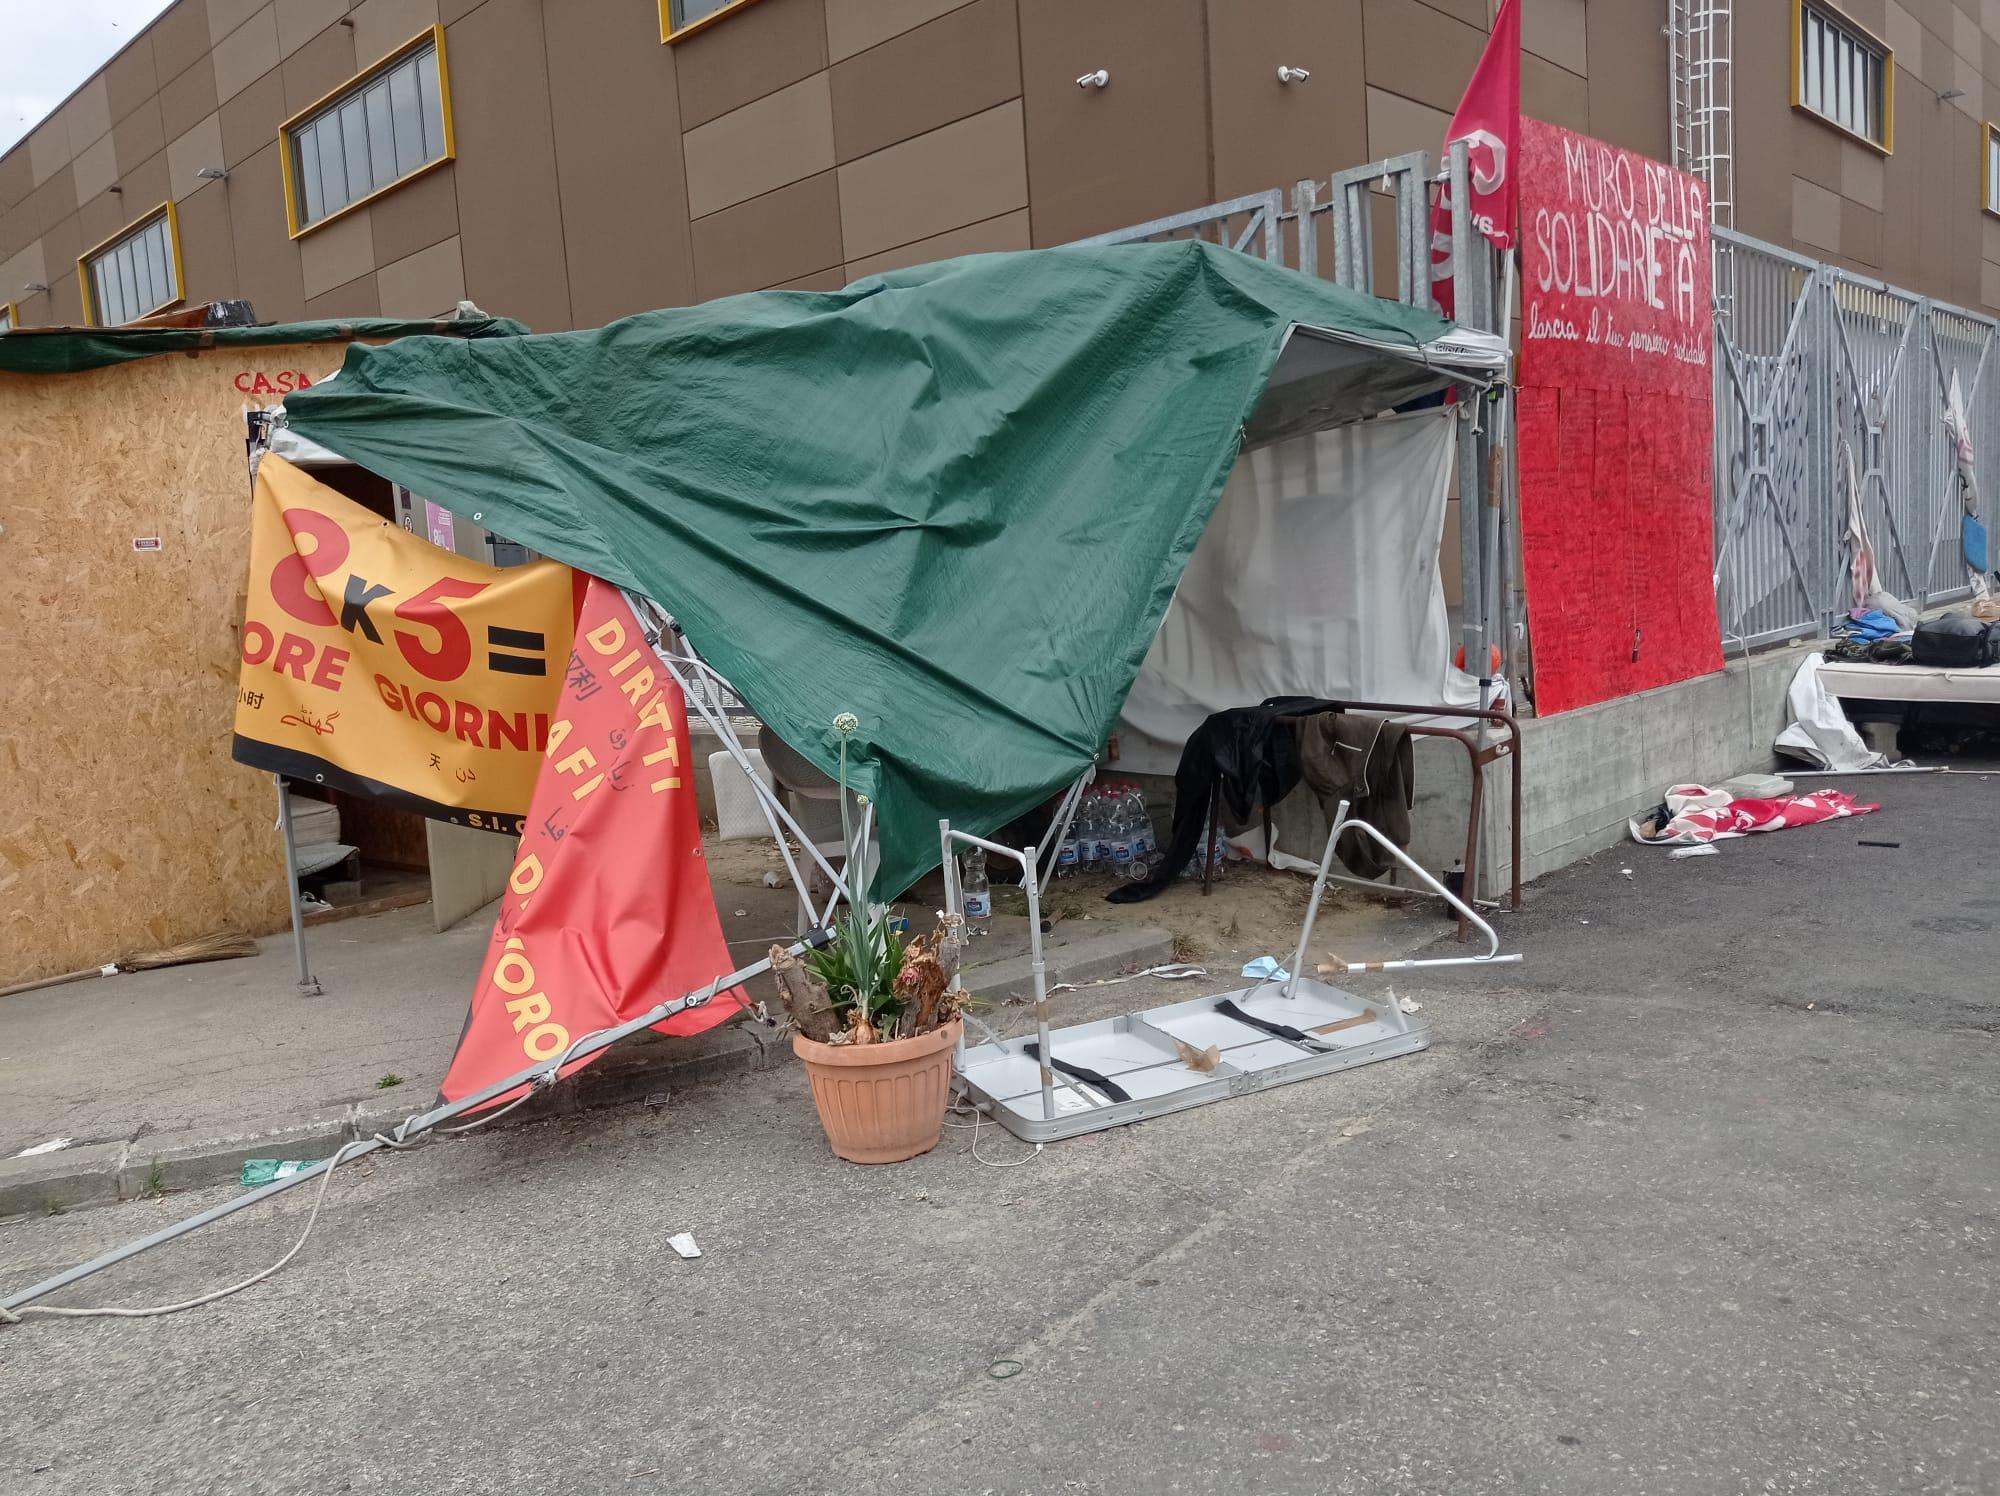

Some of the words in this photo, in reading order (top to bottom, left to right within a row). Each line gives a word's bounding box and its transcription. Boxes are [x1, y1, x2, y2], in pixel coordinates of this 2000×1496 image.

[1564, 137, 1634, 220] MURO
[1644, 160, 1704, 244] DELLA
[1528, 301, 1579, 340] lascia
[1585, 306, 1600, 344] il
[1605, 309, 1625, 348] tuo
[1628, 323, 1671, 364] pensiero
[1674, 331, 1707, 368] solidale
[235, 371, 312, 394] CASA
[242, 620, 351, 692] ORE
[374, 673, 551, 752] GIORNI
